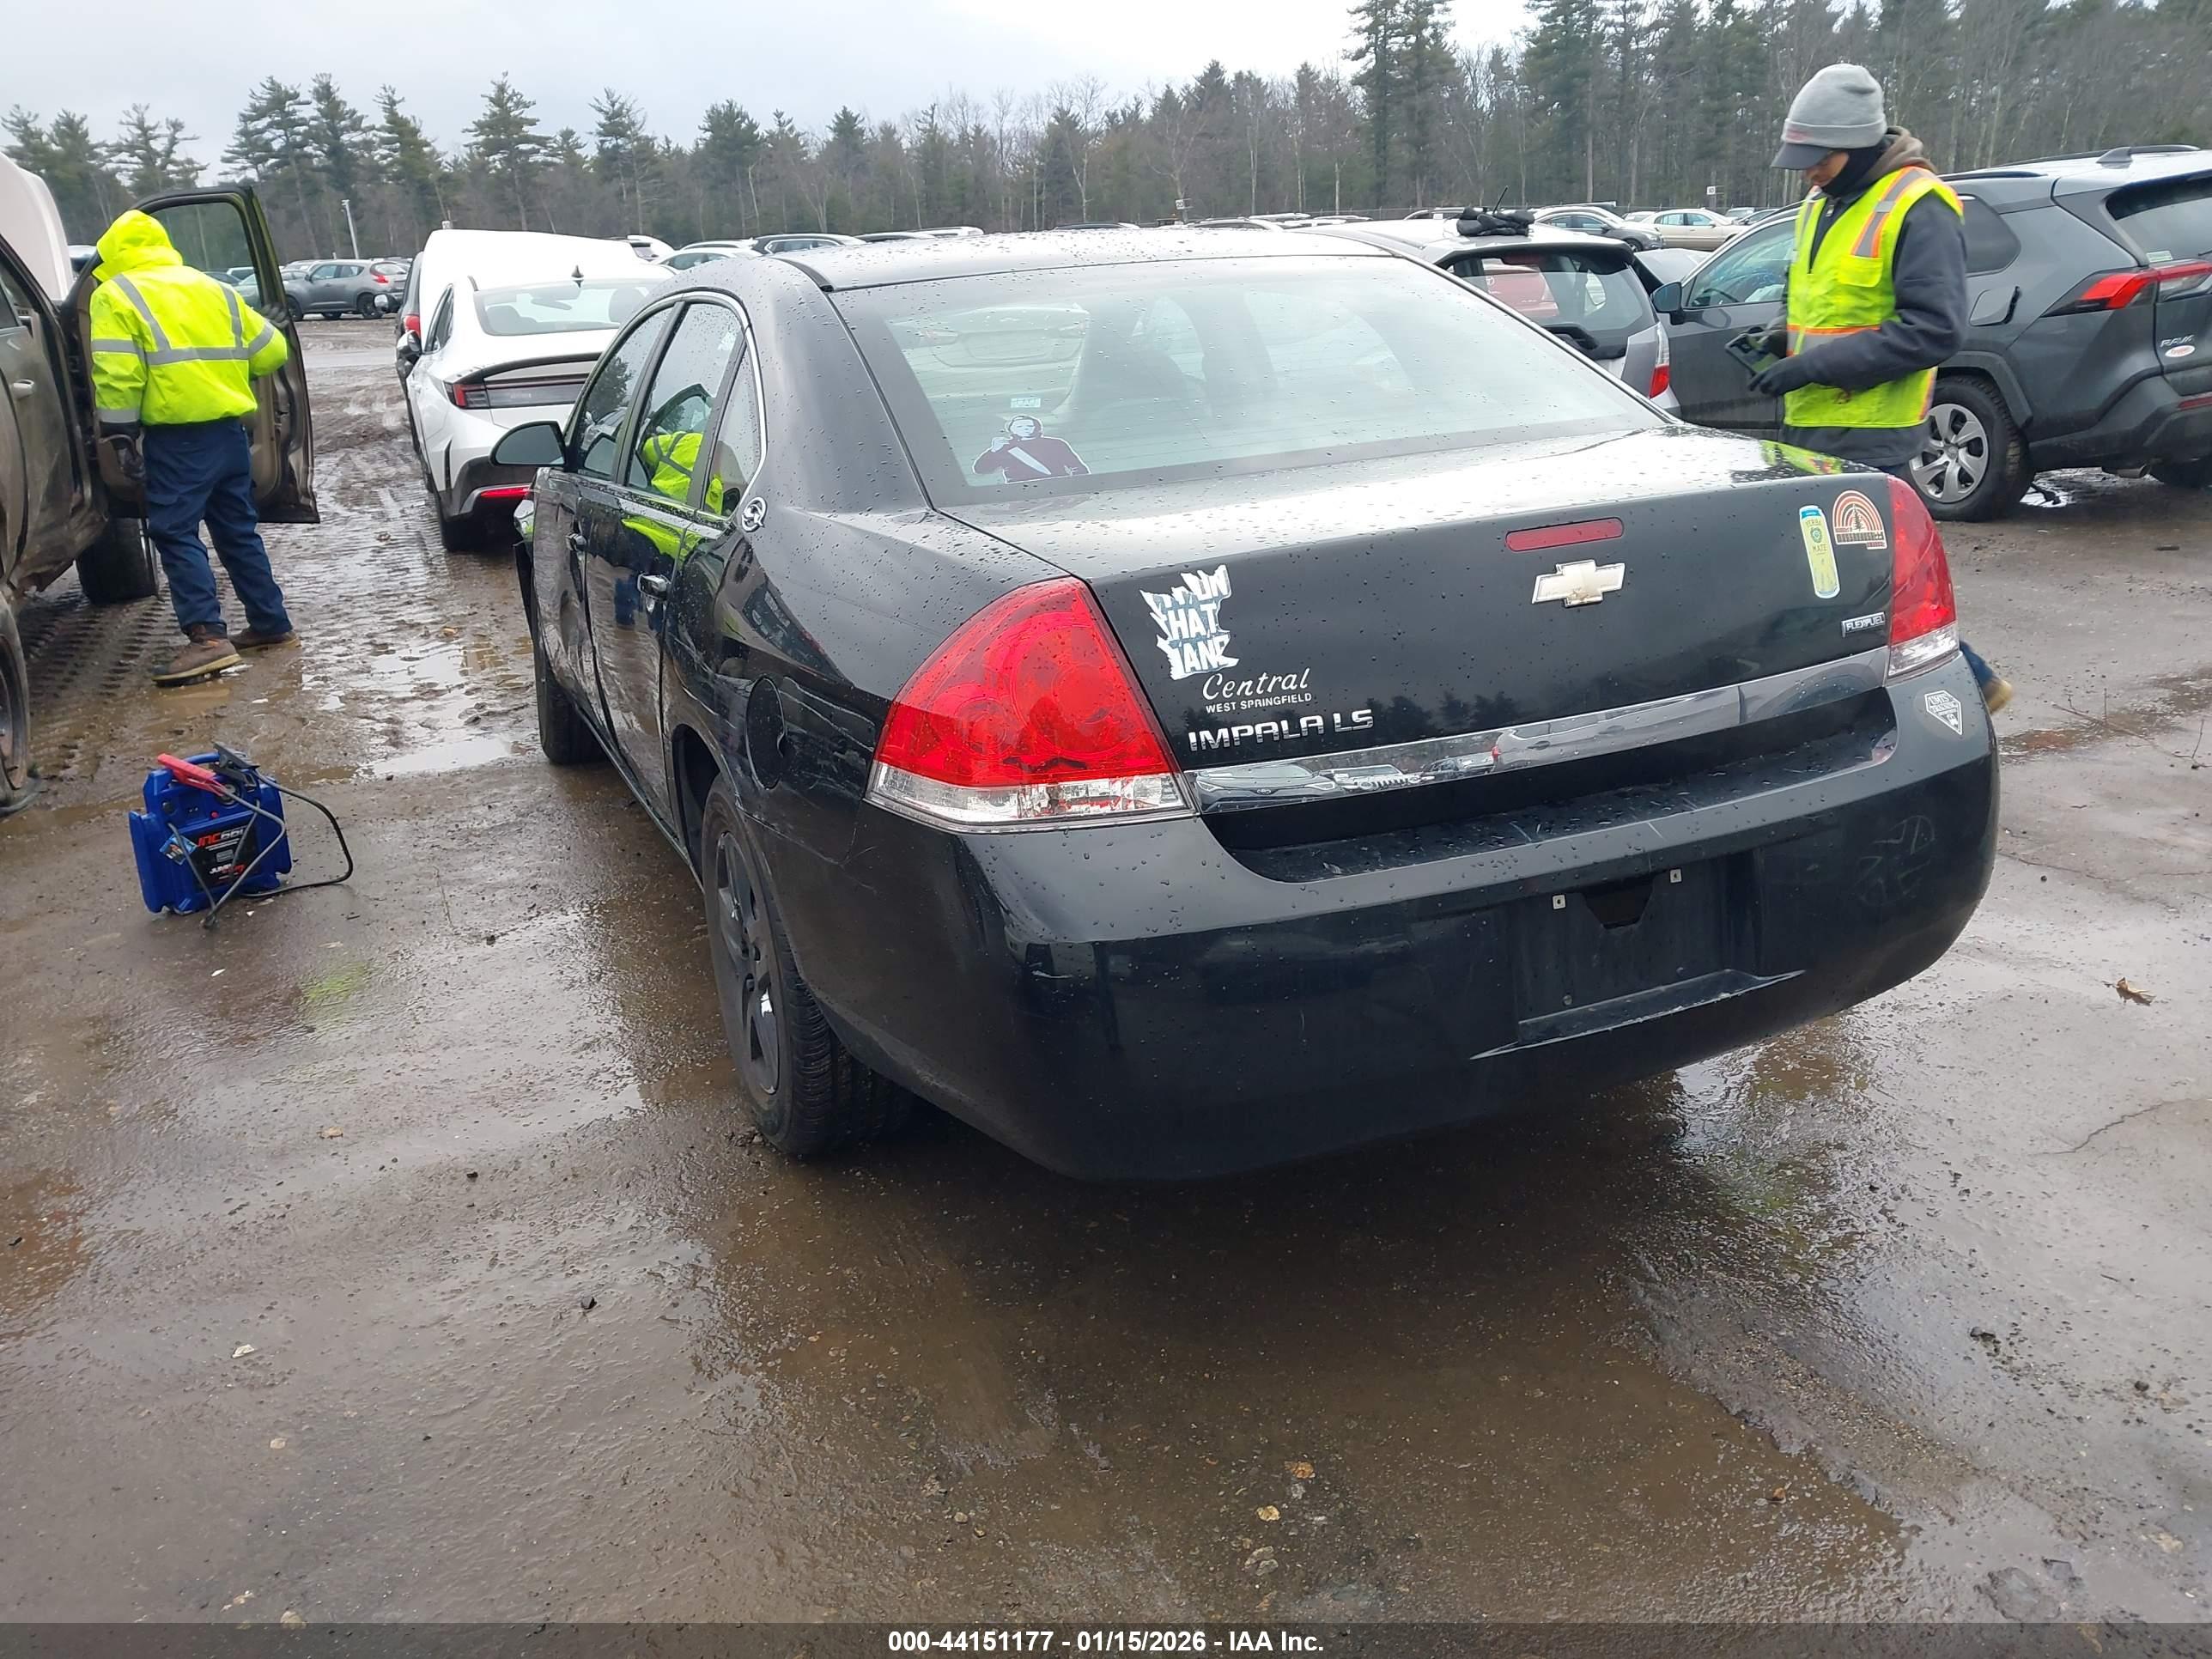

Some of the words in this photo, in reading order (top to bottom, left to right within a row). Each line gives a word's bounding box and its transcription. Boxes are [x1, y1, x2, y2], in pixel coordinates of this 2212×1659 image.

[1202, 667, 1310, 700] Central
[1206, 702, 1237, 714] WEST
[1240, 692, 1312, 709] SPRINGFIELD
[1188, 714, 1324, 751] IMPALA
[1333, 709, 1373, 732] LS
